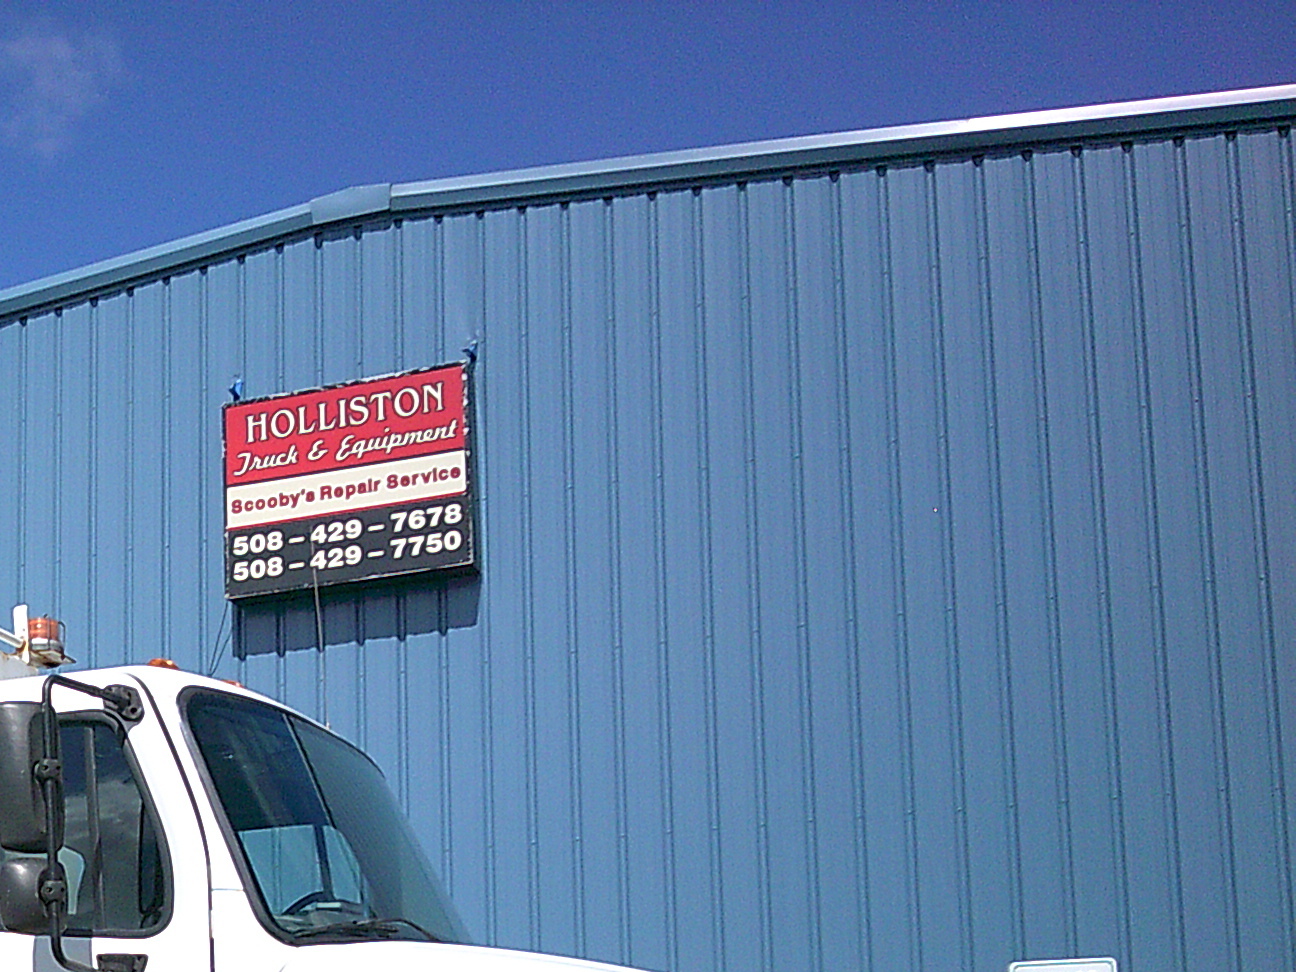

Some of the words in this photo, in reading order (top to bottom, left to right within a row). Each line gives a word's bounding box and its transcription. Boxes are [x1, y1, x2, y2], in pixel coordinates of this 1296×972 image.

[246, 382, 445, 443] HOLLISTON
[233, 445, 299, 476] Truck
[307, 439, 329, 461] &
[336, 419, 459, 461] Equipment
[231, 489, 315, 514] Scooby's
[320, 478, 381, 500] Repair
[386, 466, 462, 490] Service
